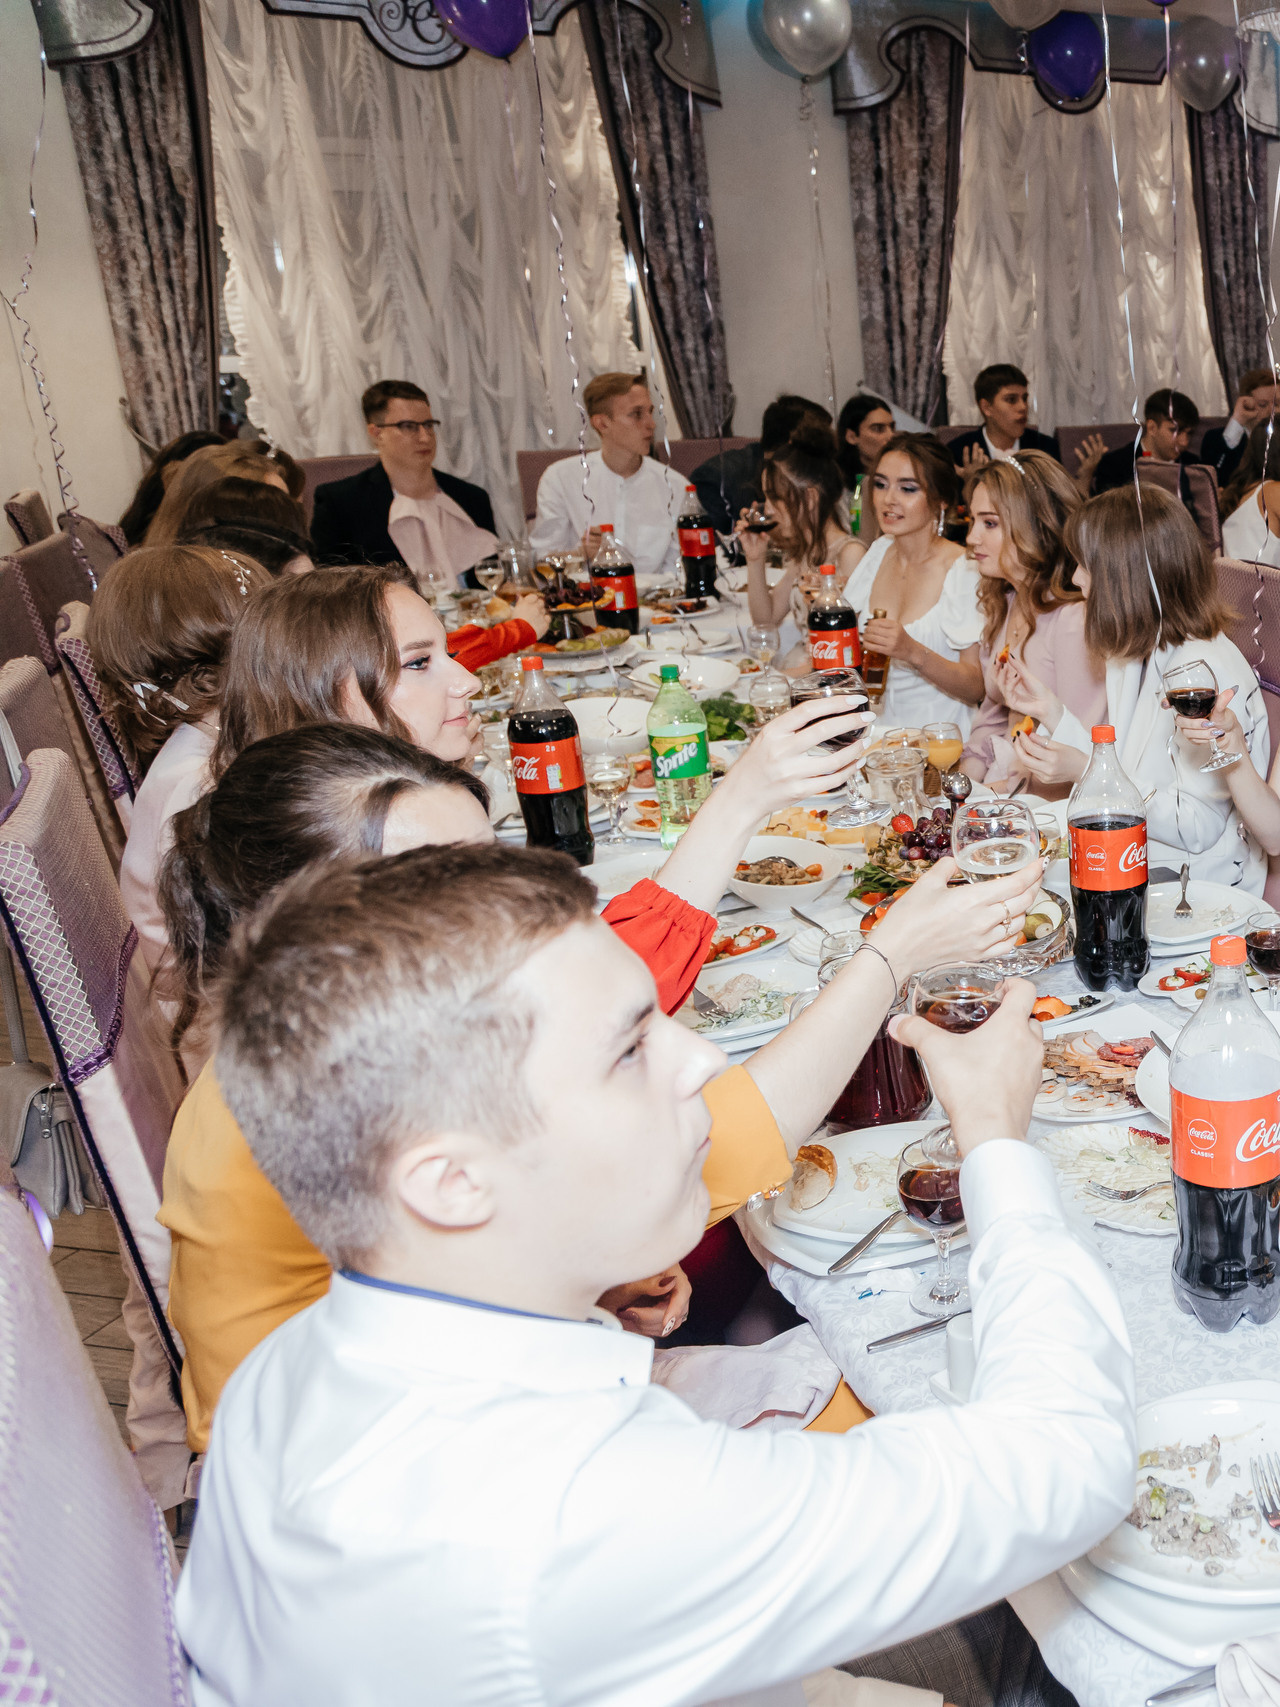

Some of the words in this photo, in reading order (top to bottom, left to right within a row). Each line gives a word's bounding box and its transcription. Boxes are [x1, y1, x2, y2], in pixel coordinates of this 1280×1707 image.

[656, 742, 698, 778] Sprite
[1189, 1127, 1214, 1141] Coca-Cola
[1190, 1148, 1214, 1159] CLASSIC
